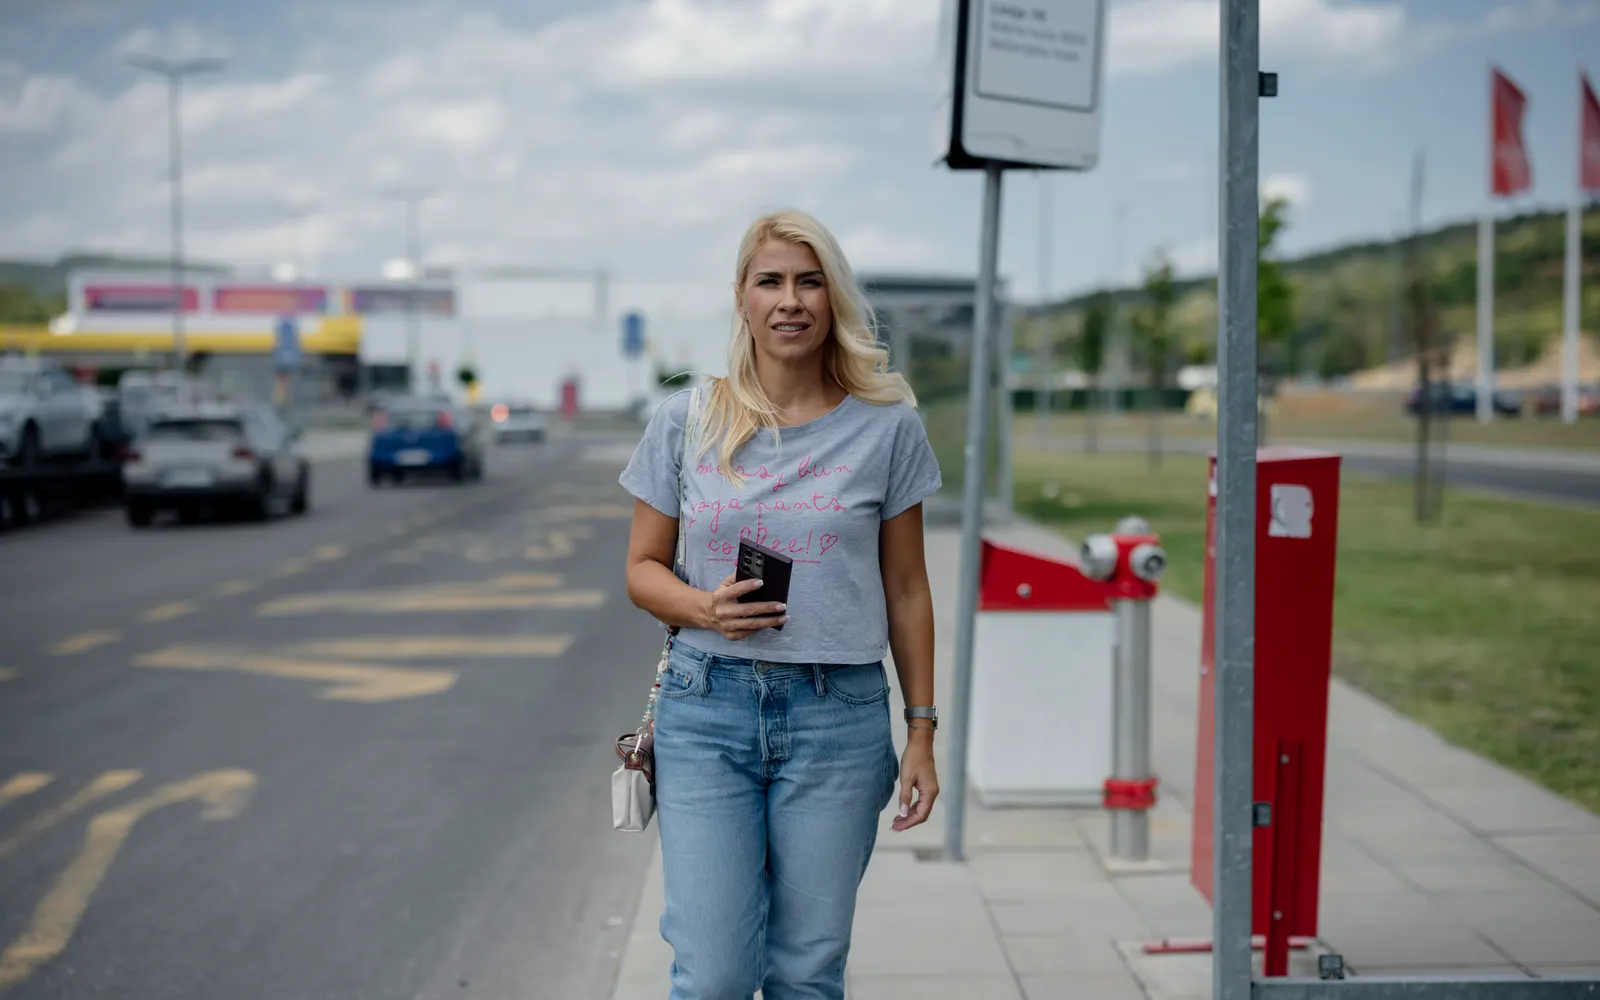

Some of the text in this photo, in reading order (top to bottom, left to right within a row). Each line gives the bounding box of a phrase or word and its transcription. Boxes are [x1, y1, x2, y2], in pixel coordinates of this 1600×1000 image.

[696, 456, 852, 492] messy bun
[688, 491, 847, 533] yoga pants
